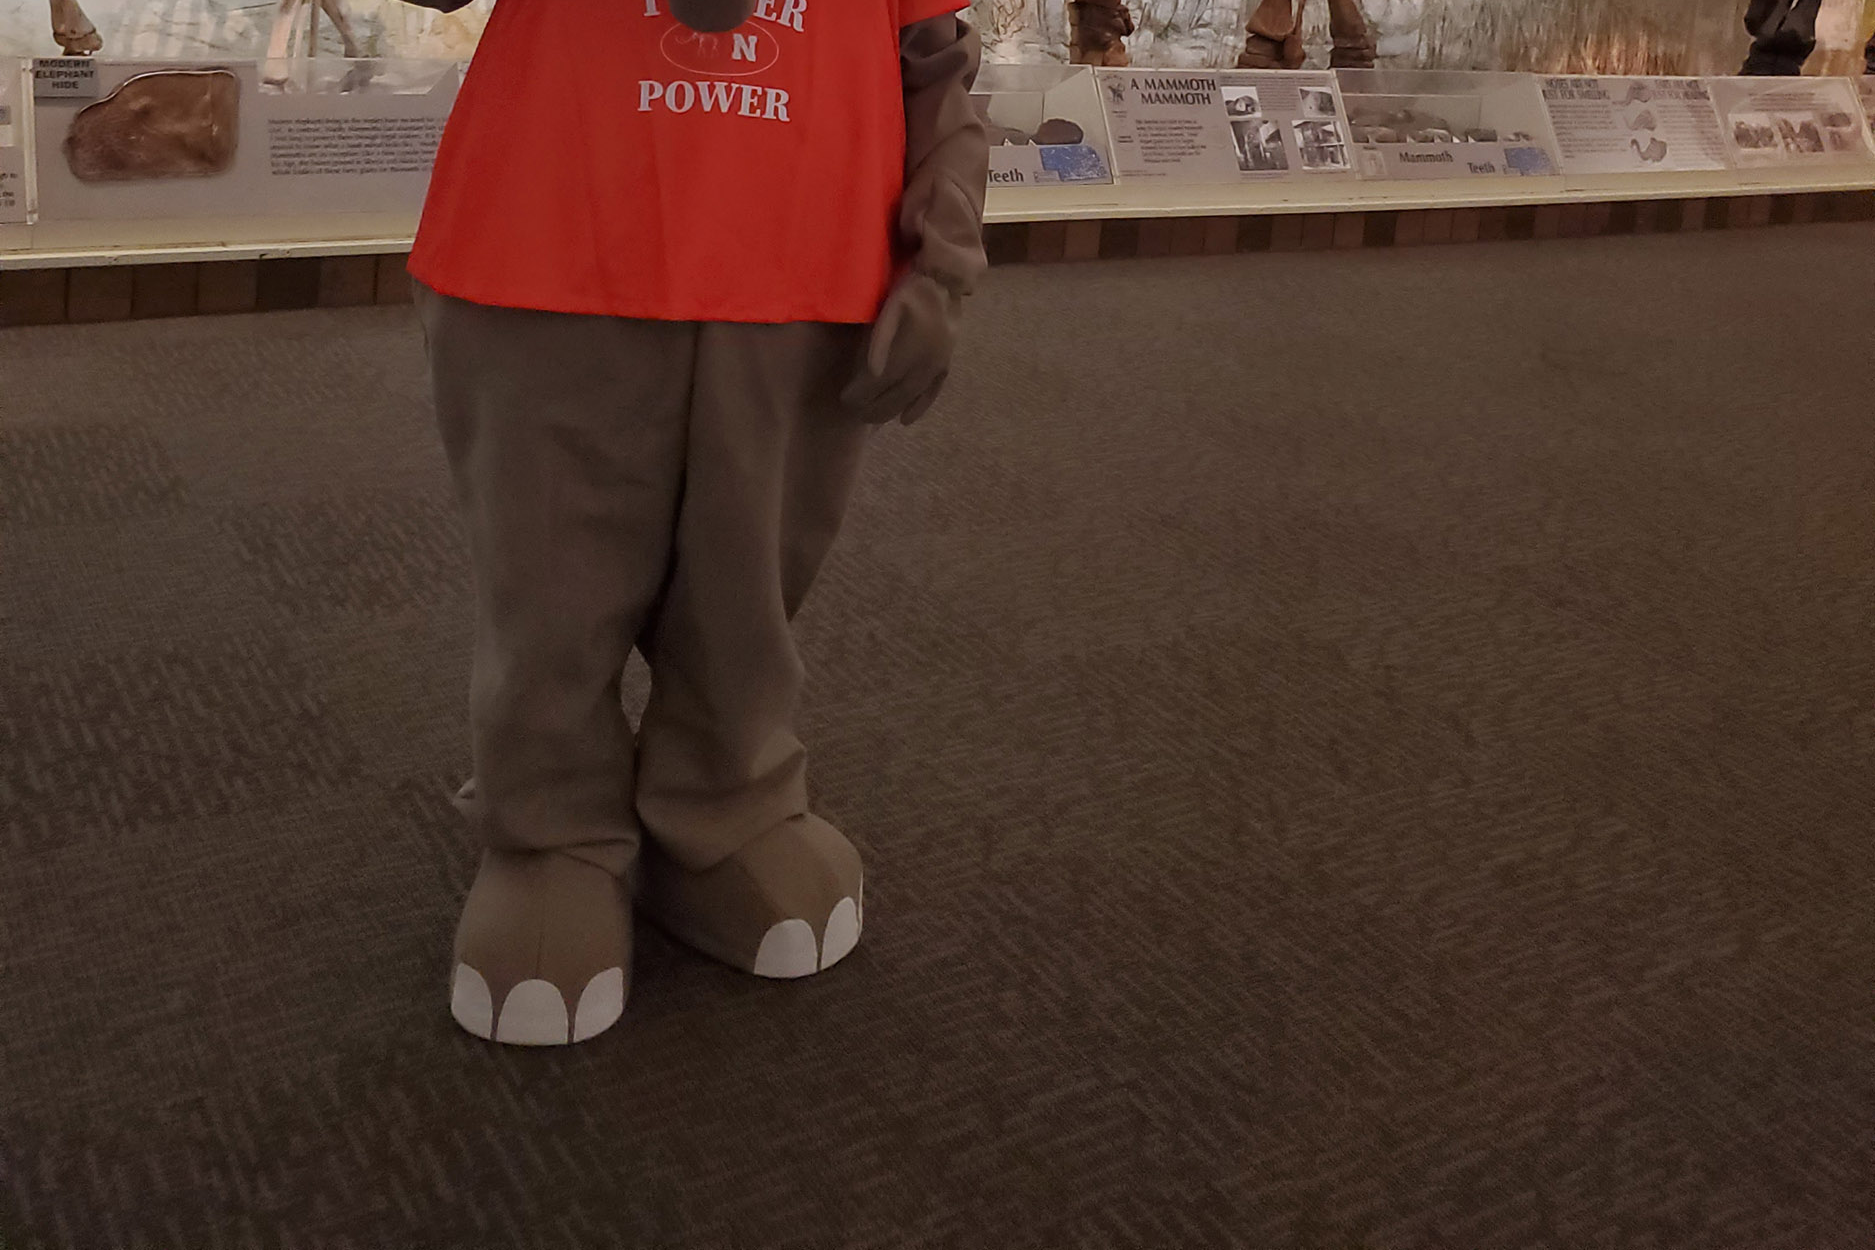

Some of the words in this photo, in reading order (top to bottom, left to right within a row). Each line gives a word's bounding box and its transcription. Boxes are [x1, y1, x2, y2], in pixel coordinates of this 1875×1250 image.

[731, 33, 757, 62] N
[39, 59, 90, 68] MODERN
[35, 70, 94, 79] ELEPHANT
[52, 81, 79, 89] HIDE
[1130, 78, 1139, 90] A
[1144, 78, 1216, 91] MAMMOTH
[637, 80, 790, 122] POWER
[1141, 93, 1211, 105] MAMMOTH
[1400, 152, 1453, 163] Mammoth
[1467, 162, 1495, 174] Teeth
[988, 168, 1024, 182] Teeth
